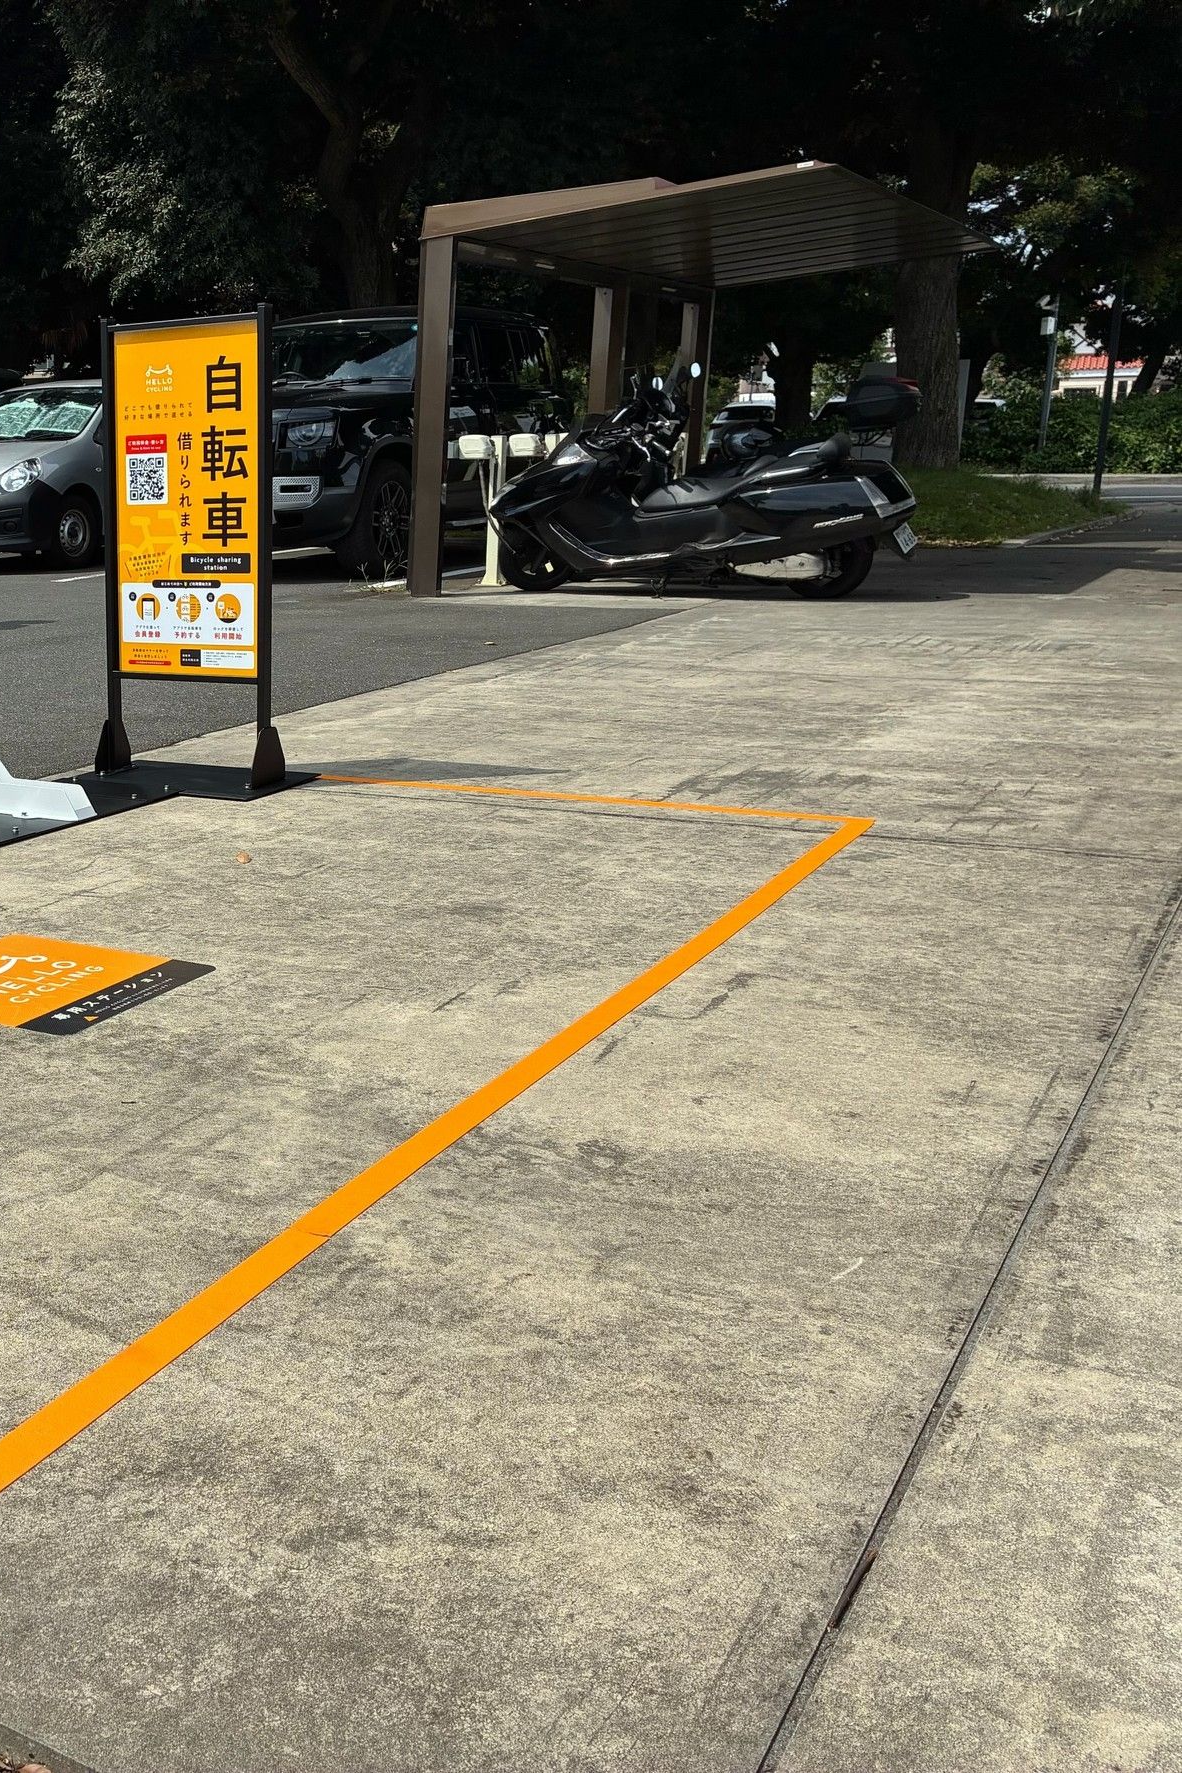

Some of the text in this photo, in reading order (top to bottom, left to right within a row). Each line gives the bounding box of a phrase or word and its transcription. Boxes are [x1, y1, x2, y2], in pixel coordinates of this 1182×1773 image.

[145, 377, 173, 386] HELLO
[201, 355, 249, 547] 自転車
[177, 431, 193, 546] 借りられます
[190, 556, 242, 565] Bicycle sharing
[174, 631, 201, 639] 予約する
[9, 966, 104, 1003] CYCLING
[51, 972, 162, 1020] 専用ステーション
